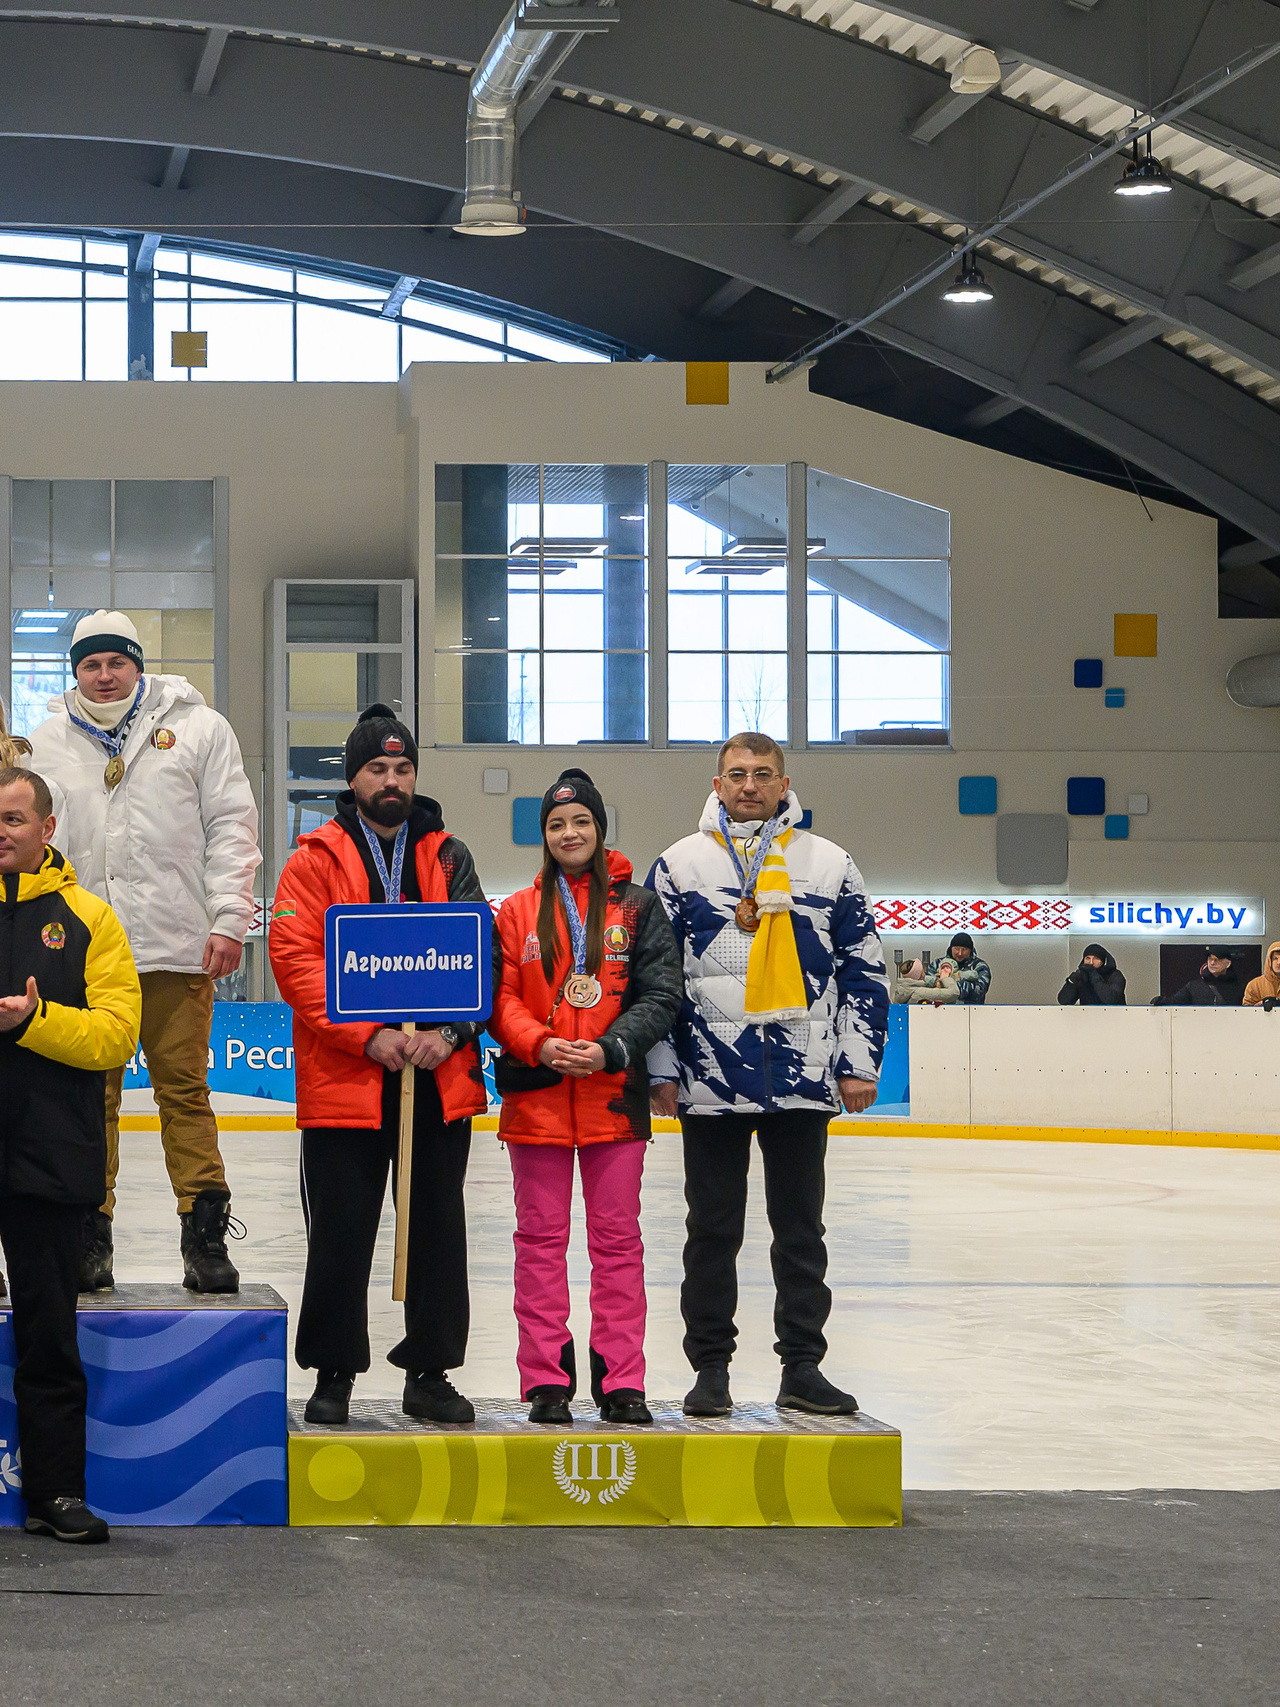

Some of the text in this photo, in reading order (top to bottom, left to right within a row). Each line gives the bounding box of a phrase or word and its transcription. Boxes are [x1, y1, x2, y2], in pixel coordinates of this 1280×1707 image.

[1089, 901, 1247, 929] silichy.by
[343, 947, 474, 979] Агрохолдинг
[567, 1443, 623, 1480] III
